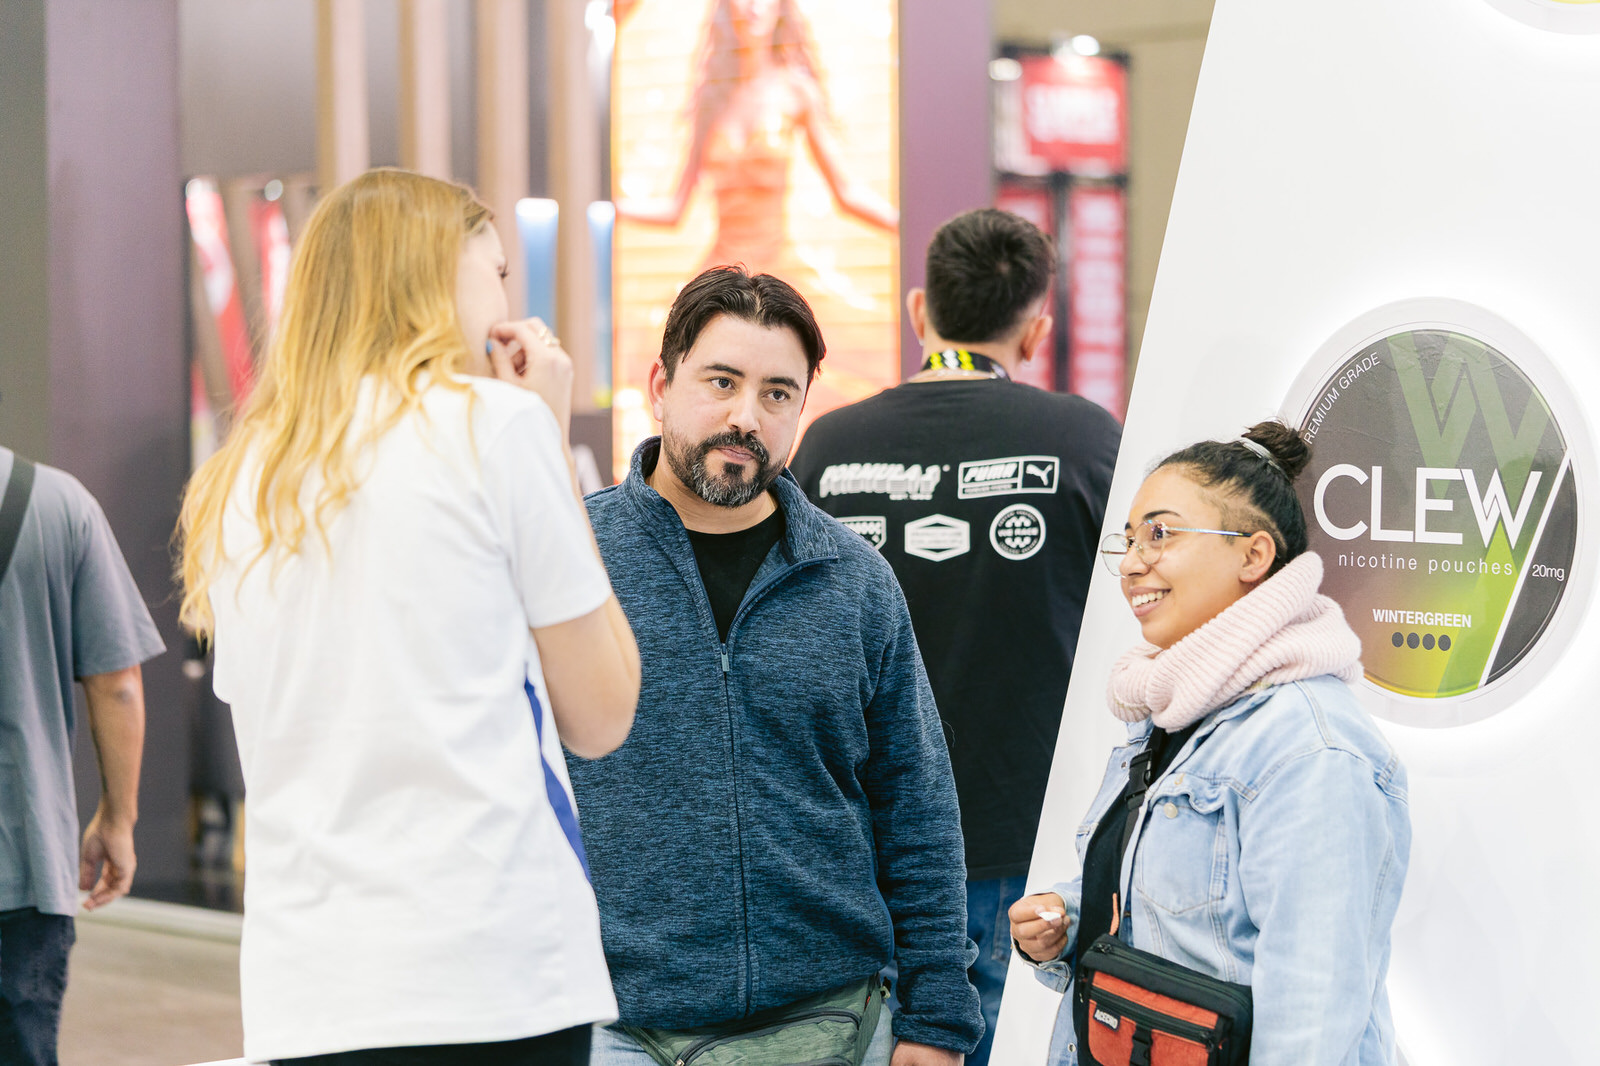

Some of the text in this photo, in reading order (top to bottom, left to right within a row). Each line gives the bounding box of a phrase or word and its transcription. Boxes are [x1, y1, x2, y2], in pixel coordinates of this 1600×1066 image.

[1303, 352, 1381, 445] REMIUM GRADE
[963, 462, 1018, 483] PUMA
[1313, 463, 1543, 550] CLEW
[1338, 551, 1514, 576] nicotine pouches
[1531, 563, 1566, 582] 20mg
[1372, 608, 1473, 629] WINTERGREEN
